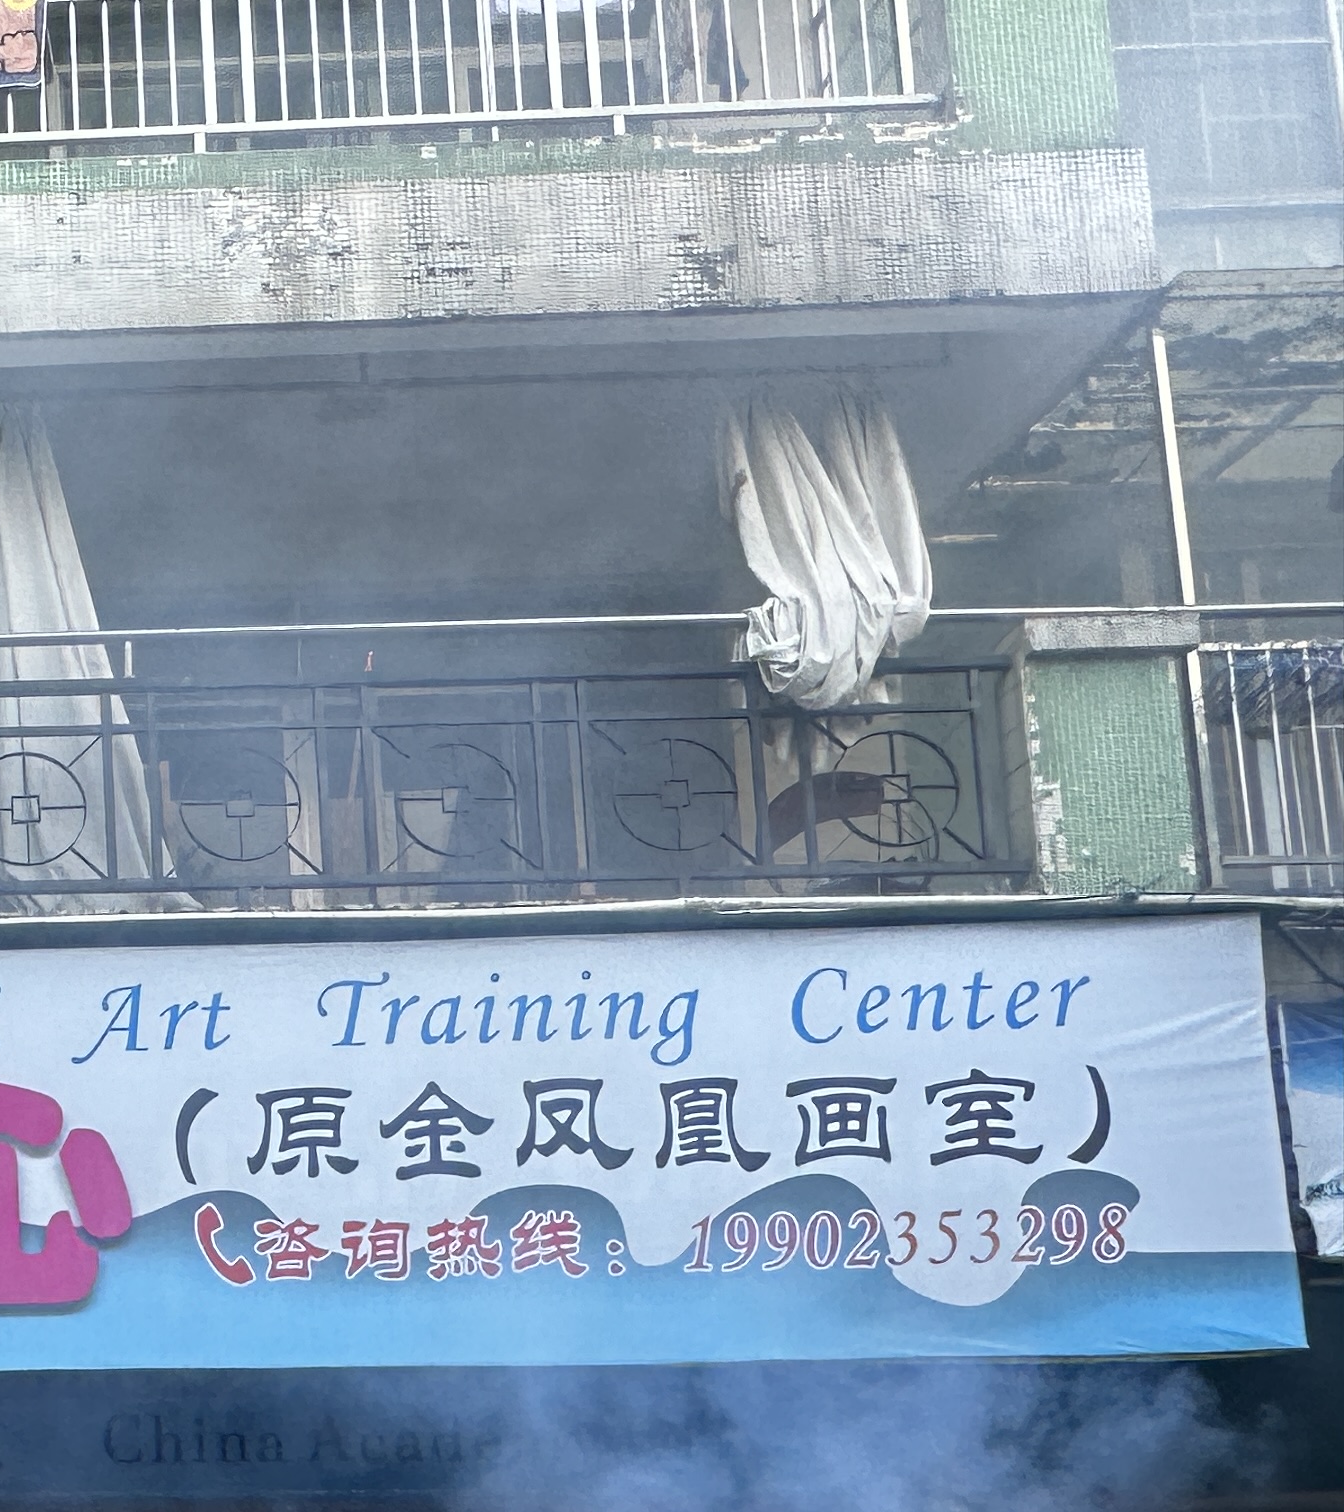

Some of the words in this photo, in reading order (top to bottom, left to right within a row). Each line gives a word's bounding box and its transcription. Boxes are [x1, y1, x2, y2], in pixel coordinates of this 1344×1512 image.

[71, 983, 232, 1065] Art
[317, 970, 701, 1066] Training
[791, 967, 1091, 1045] Center
[682, 1201, 1130, 1275] 19902353298
[103, 1413, 285, 1464] China
